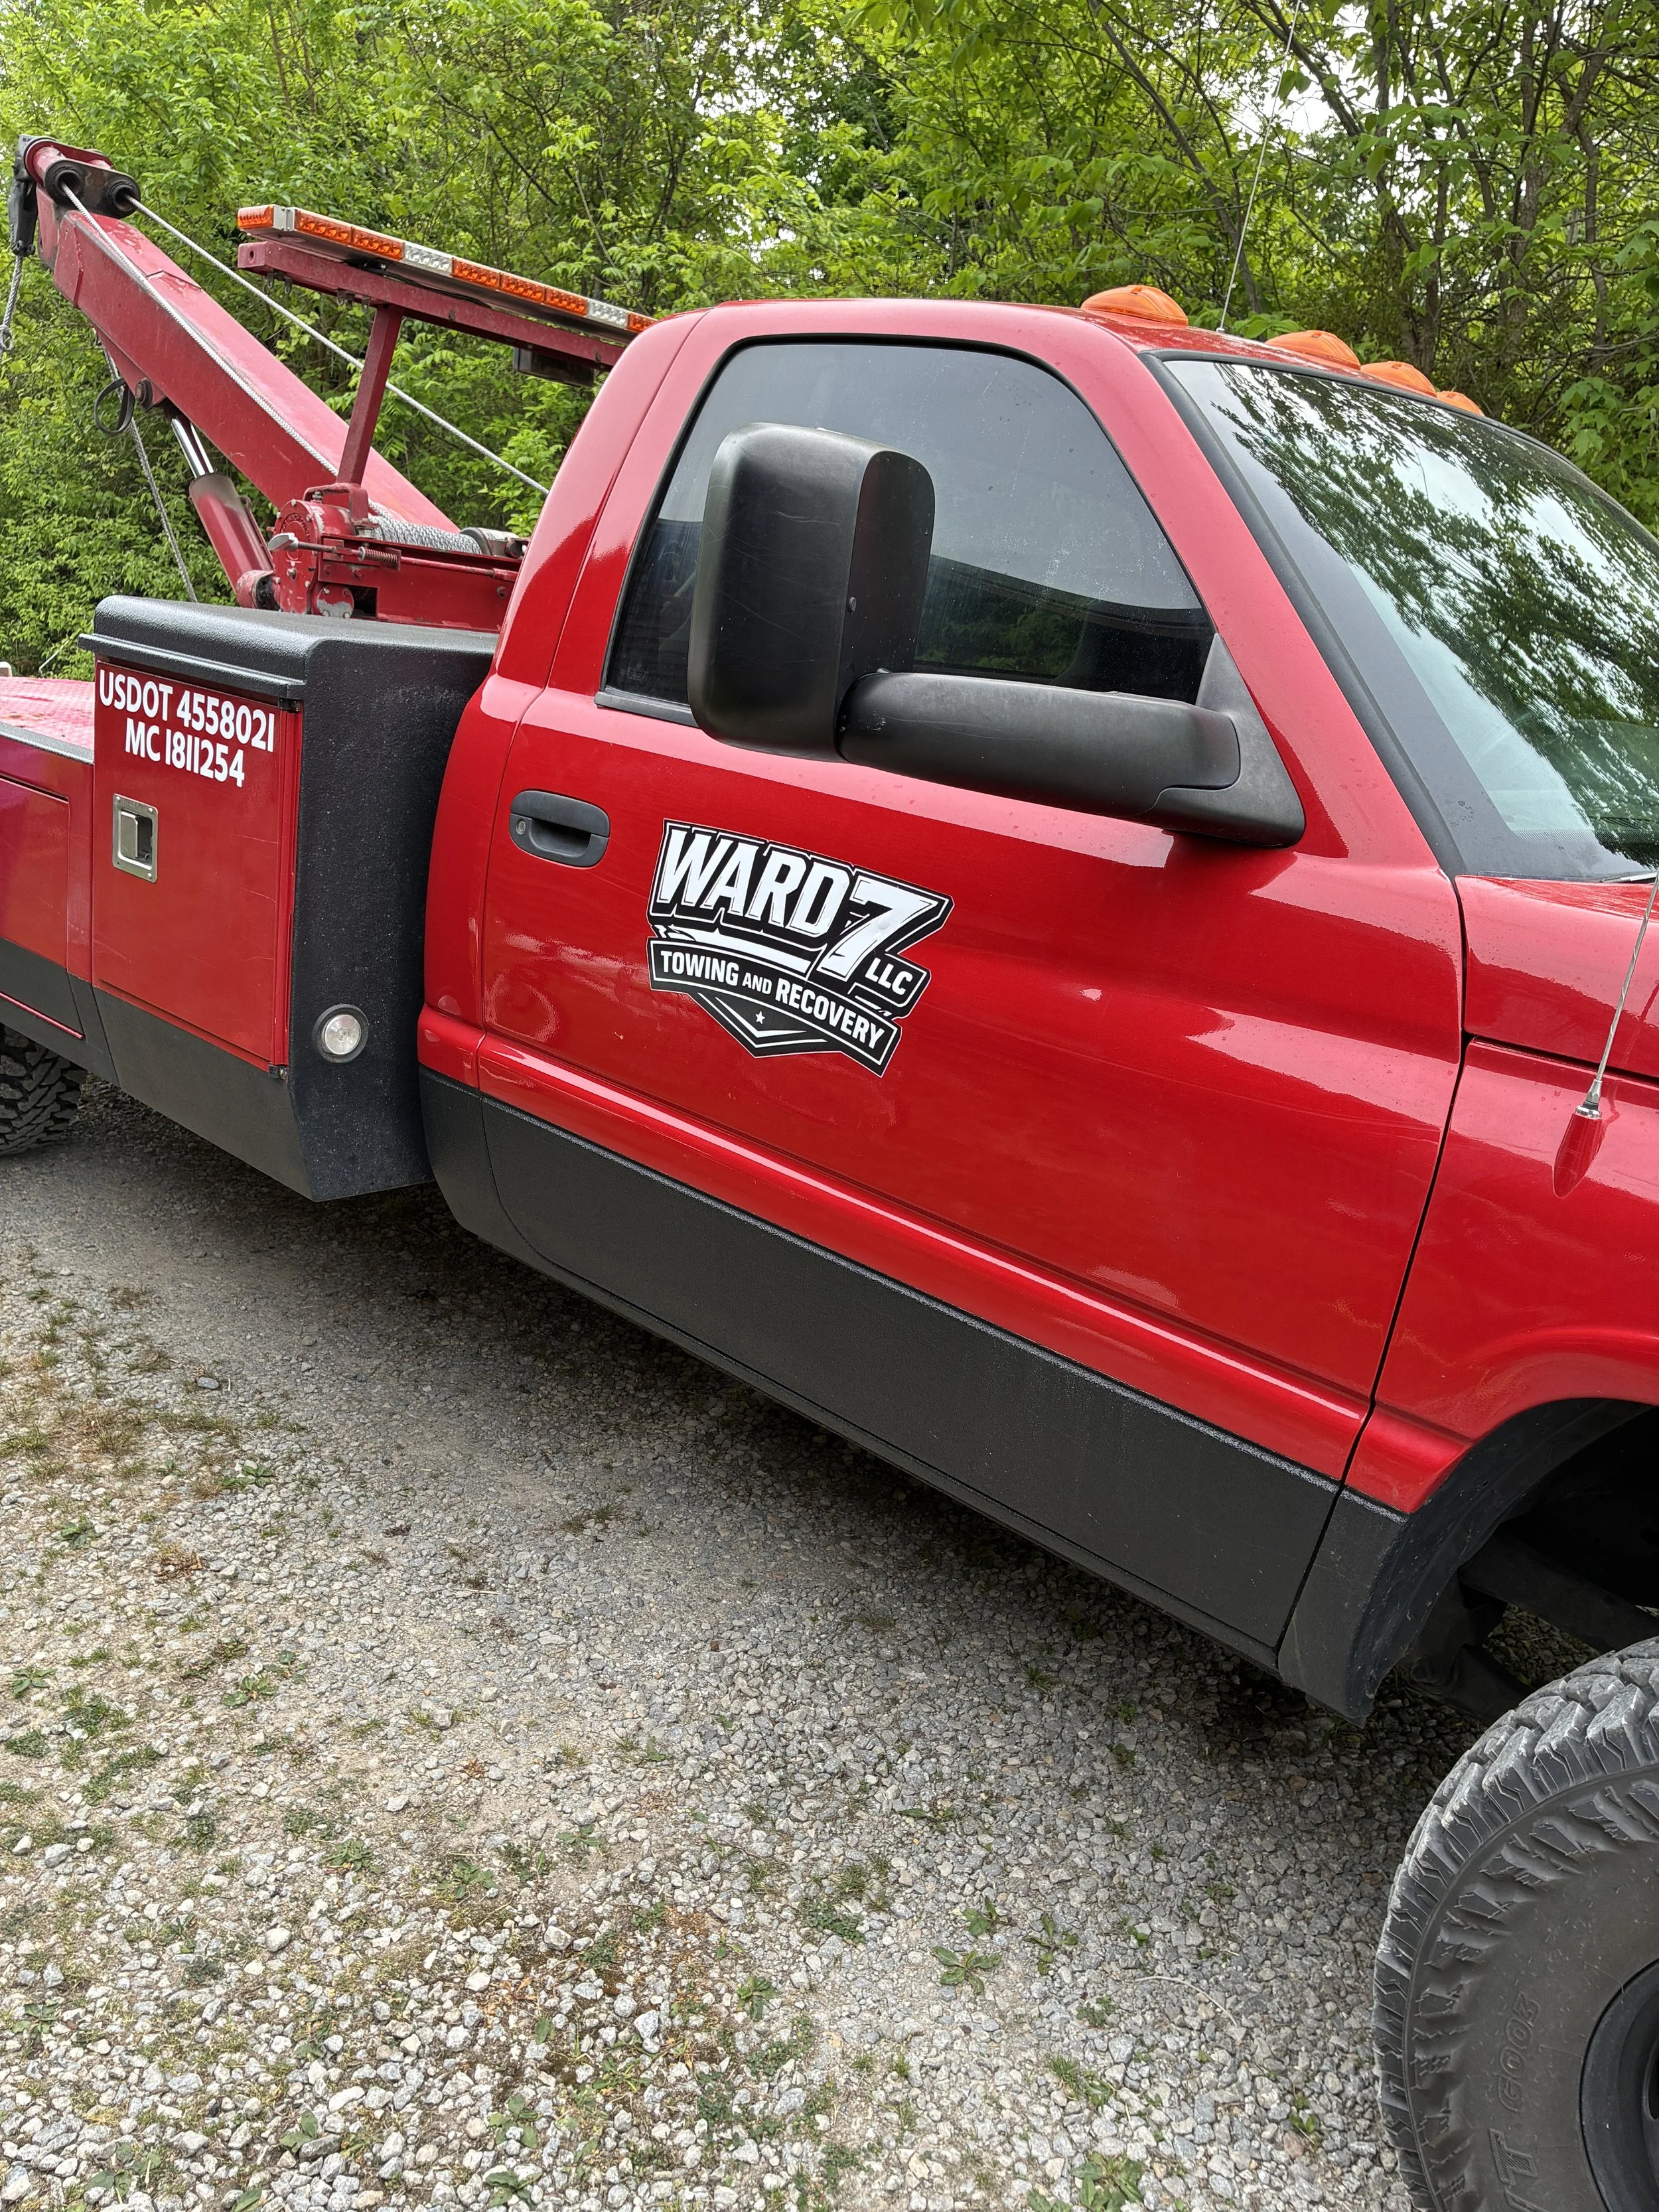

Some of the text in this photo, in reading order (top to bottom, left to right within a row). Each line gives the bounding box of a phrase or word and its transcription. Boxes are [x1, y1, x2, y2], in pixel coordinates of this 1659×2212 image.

[100, 669, 275, 753] USDOT 4558021
[125, 717, 245, 788] MC 1811254
[656, 829, 938, 982] WARD 7
[660, 950, 885, 1050] TOWING AND RECOVERY
[865, 957, 914, 995] LLC
